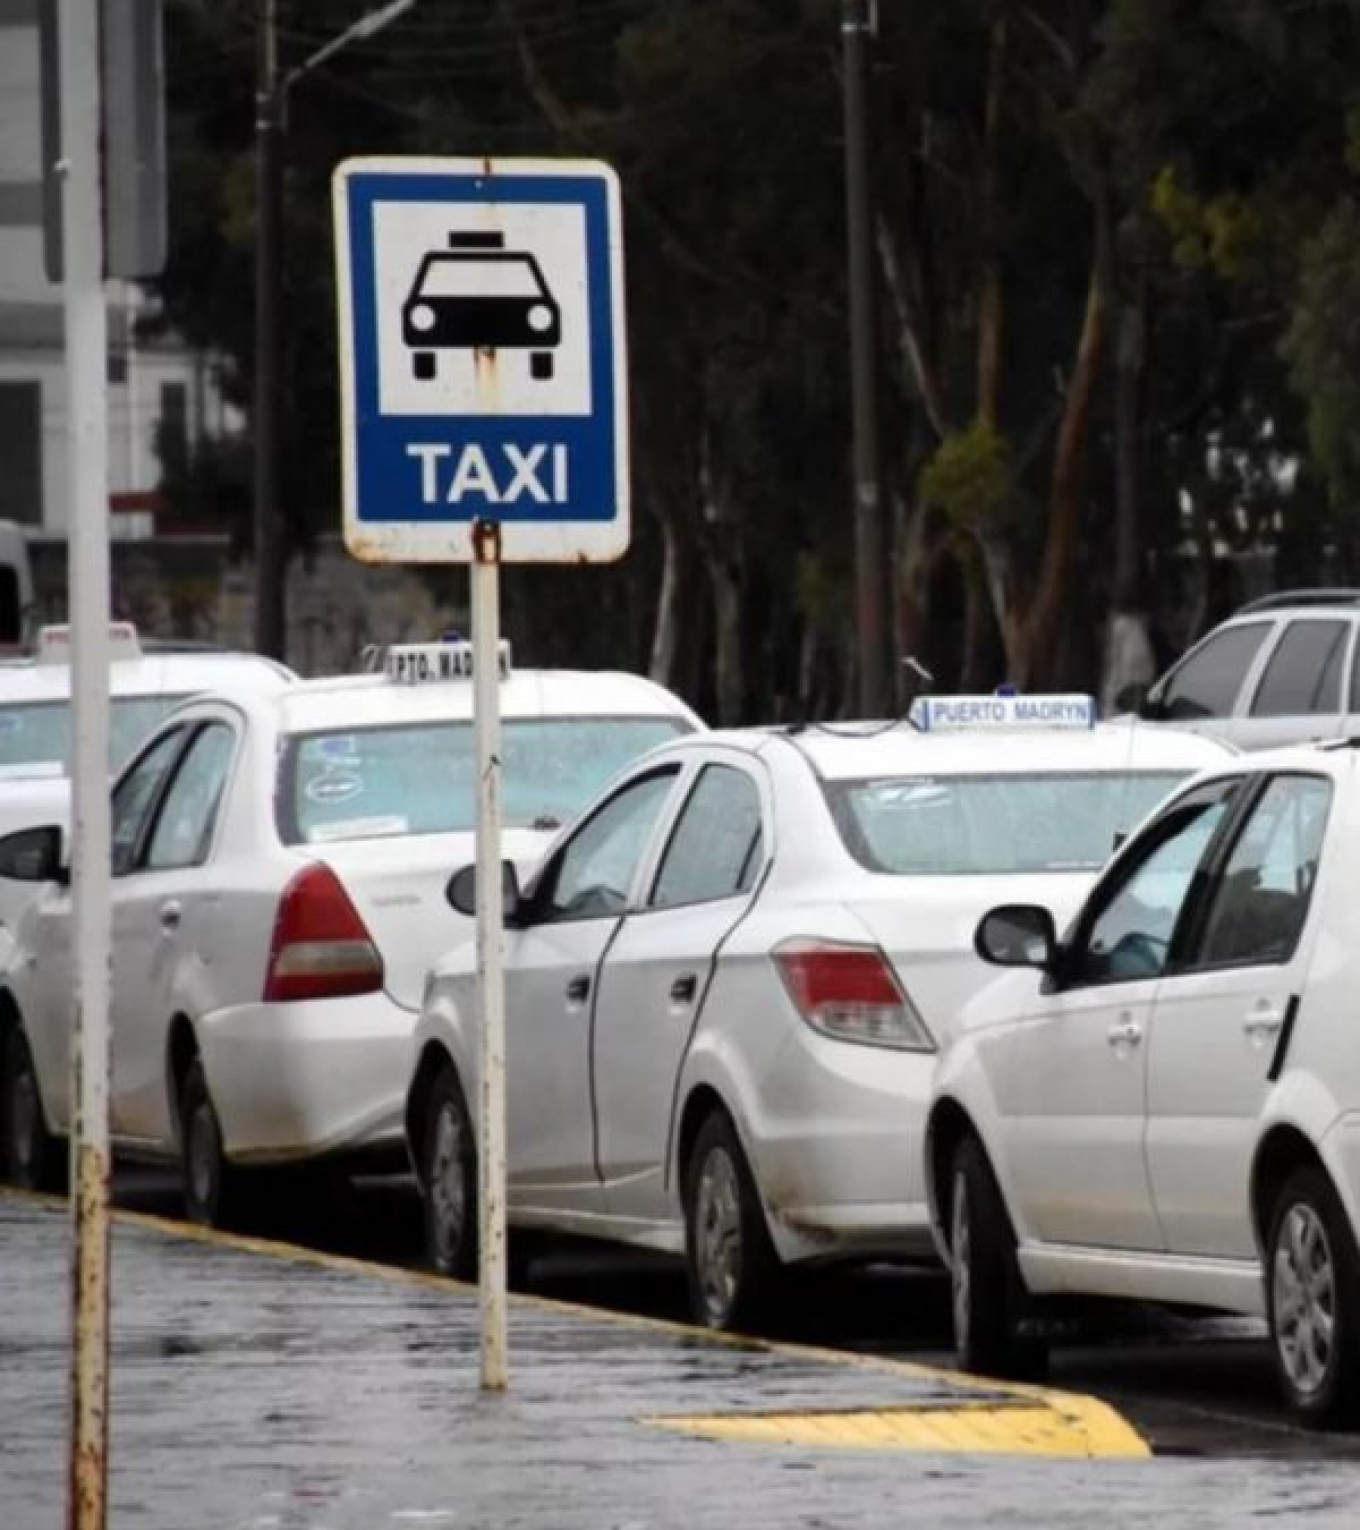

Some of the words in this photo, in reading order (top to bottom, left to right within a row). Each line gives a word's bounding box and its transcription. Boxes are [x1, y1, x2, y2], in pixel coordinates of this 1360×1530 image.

[406, 443, 569, 504] TAXI
[934, 702, 1005, 721] PUERTO
[1014, 702, 1088, 720] MADRYN
